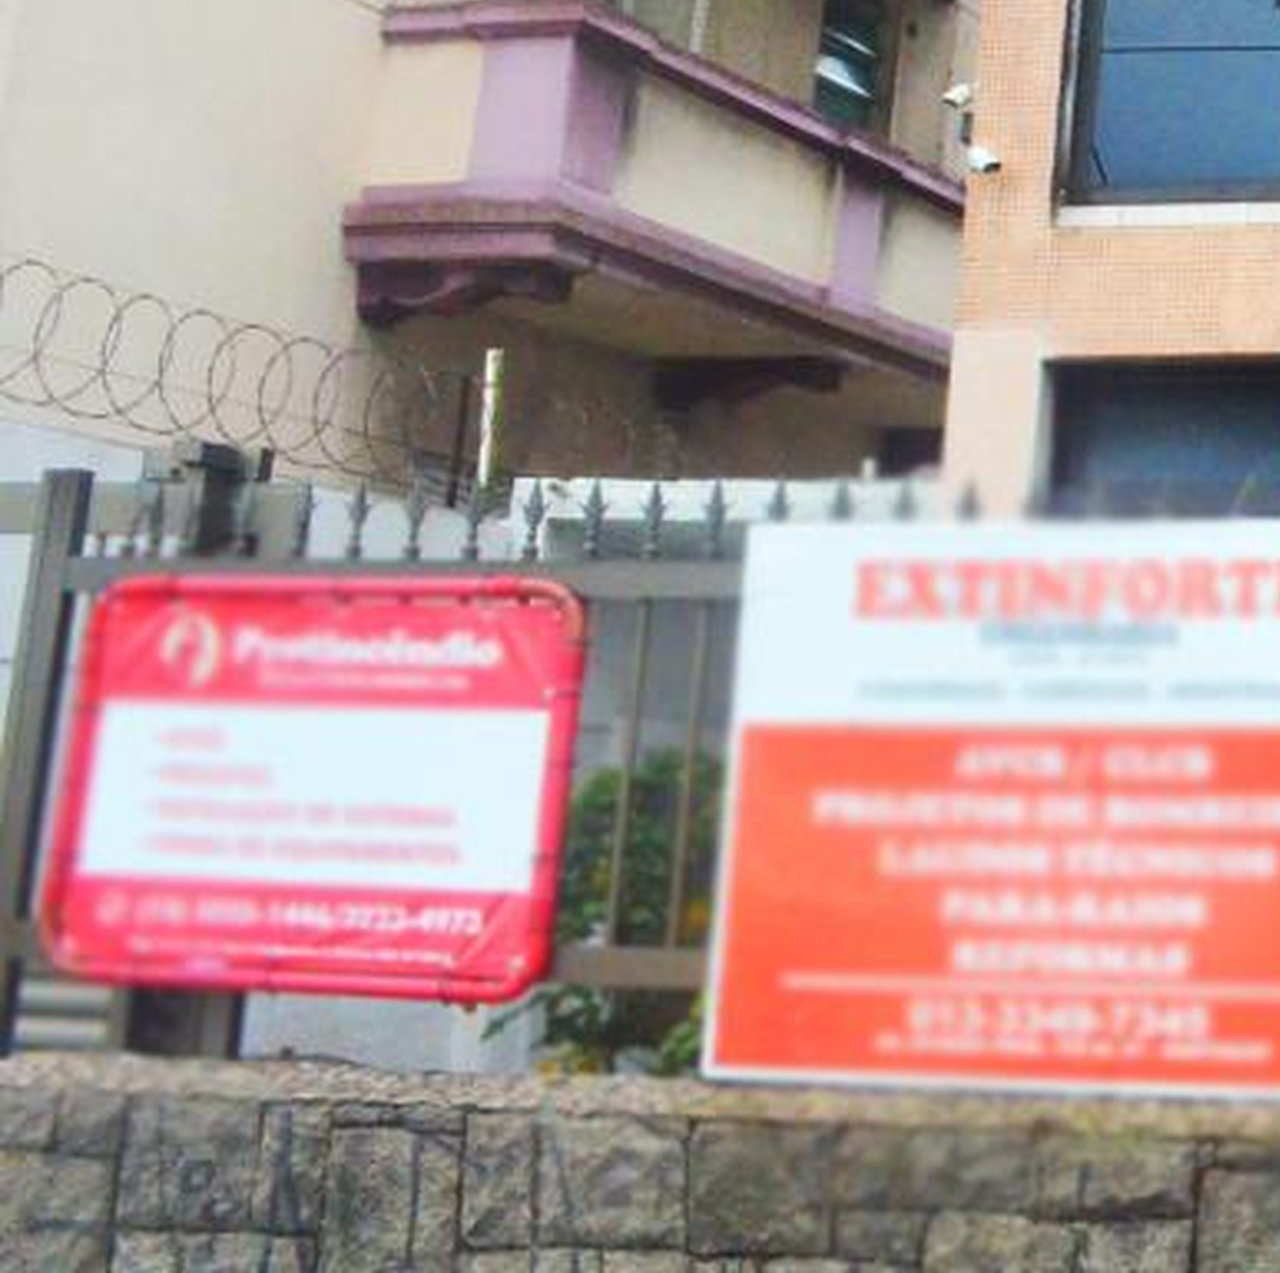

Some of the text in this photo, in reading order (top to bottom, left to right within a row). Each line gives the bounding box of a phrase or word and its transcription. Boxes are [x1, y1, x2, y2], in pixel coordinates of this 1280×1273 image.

[813, 793, 1026, 826] PROJETOS
[1036, 795, 1090, 827] DE
[940, 893, 1208, 928] PARA-RAIOS
[952, 941, 1190, 975] REFORMAS
